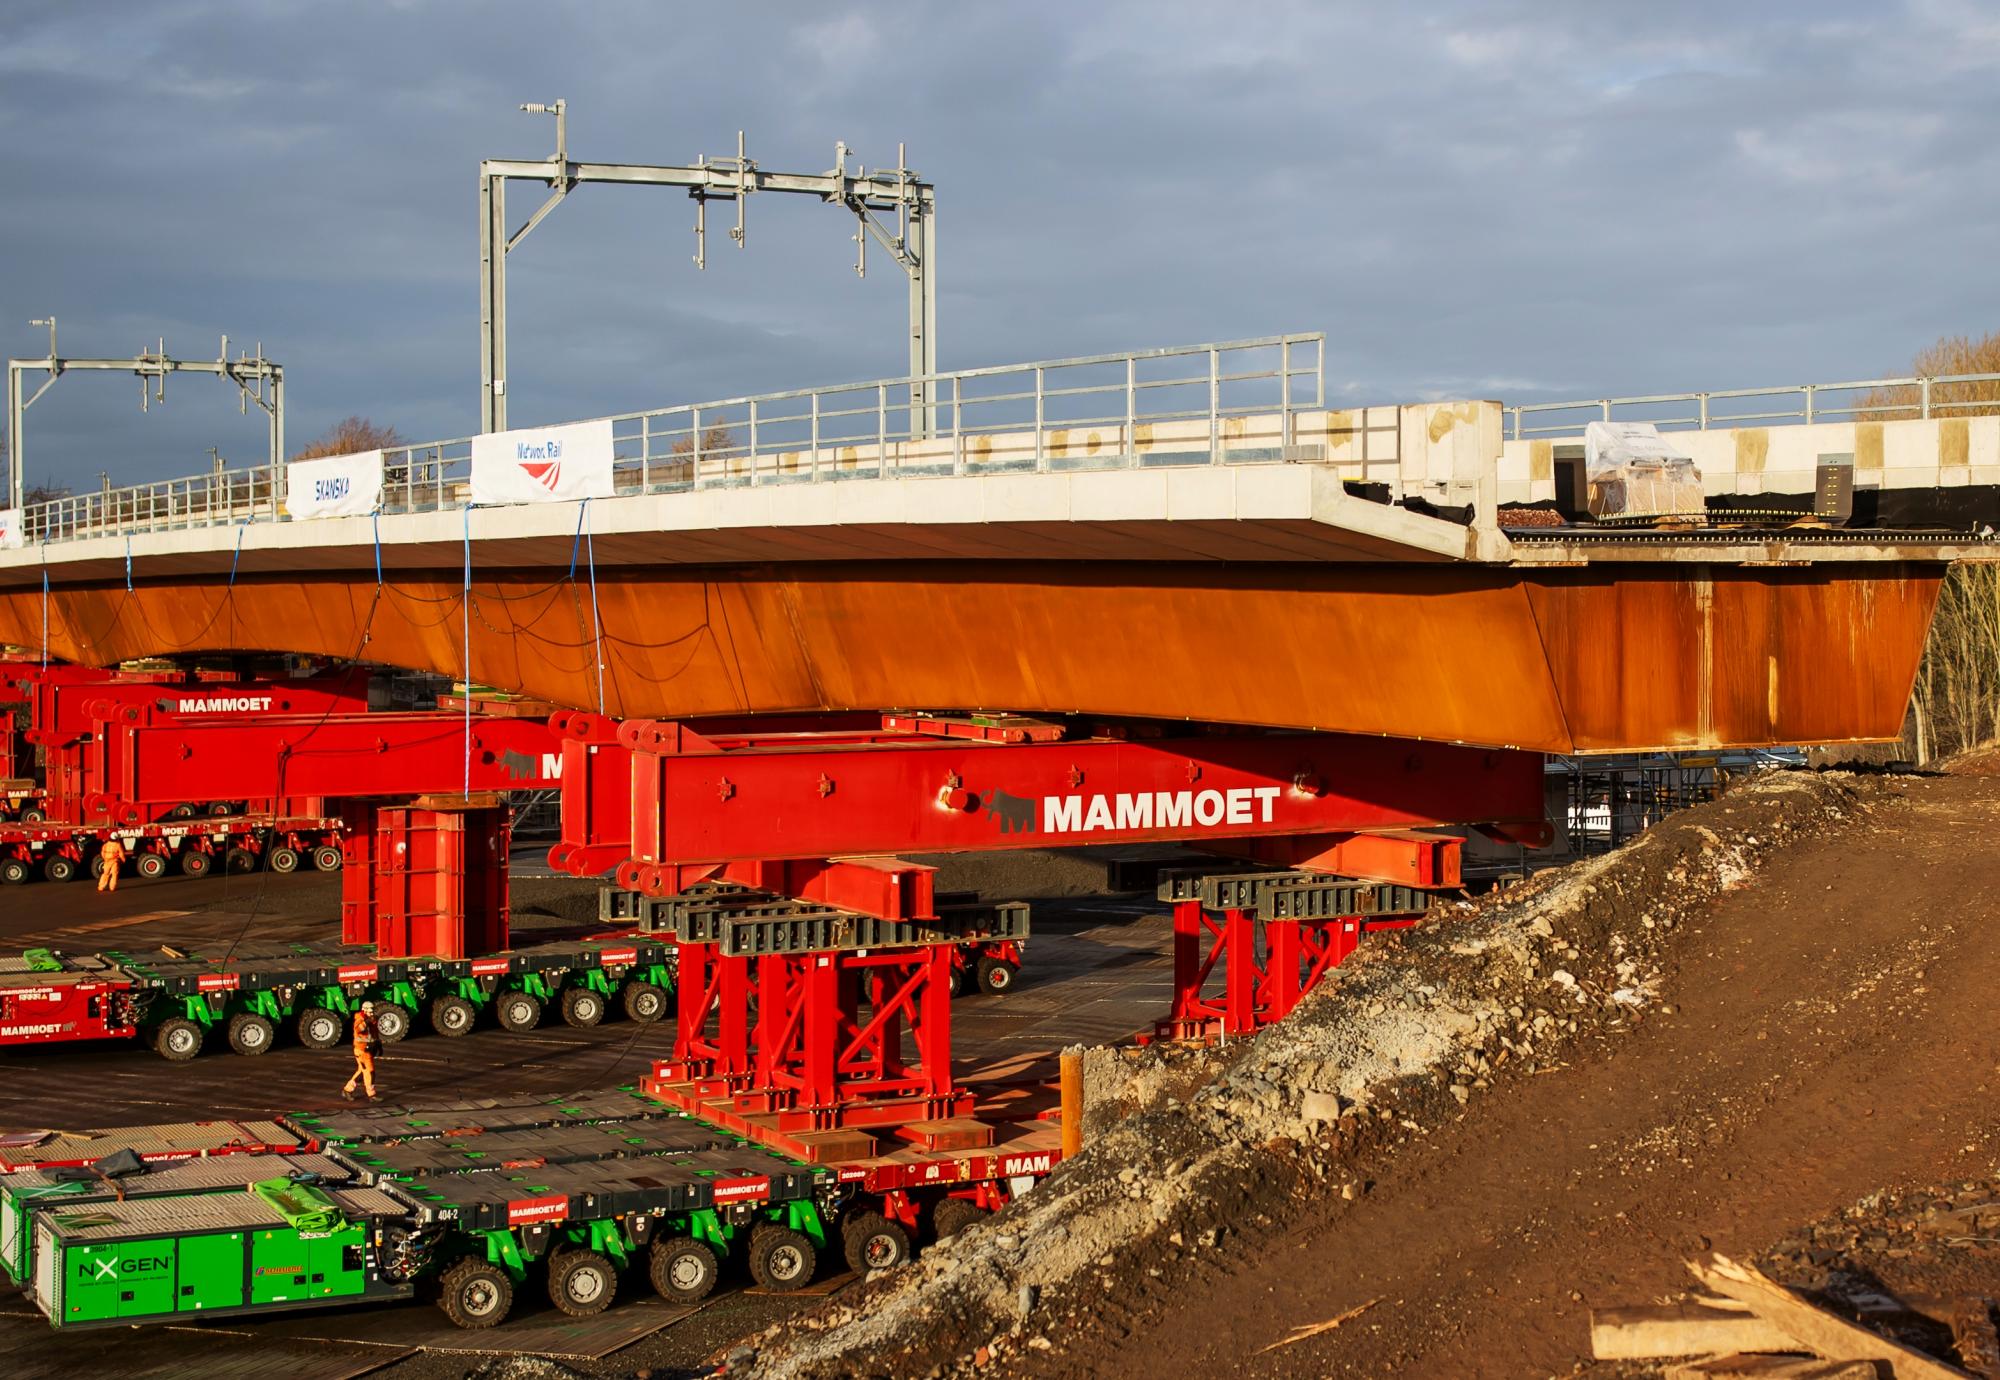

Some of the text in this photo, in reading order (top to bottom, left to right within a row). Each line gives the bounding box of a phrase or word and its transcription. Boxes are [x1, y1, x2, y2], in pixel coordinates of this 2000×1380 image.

[315, 477, 349, 501] SKANSKA
[179, 697, 271, 713] MAMMOET
[1044, 787, 1280, 833] MAMMOET
[1, 1023, 61, 1036] MAMMOET
[1006, 1156, 1050, 1175] MAM
[715, 1185, 757, 1197] MAMMOET
[438, 1208, 458, 1221] 404-2
[510, 1204, 556, 1217] MAMMOET
